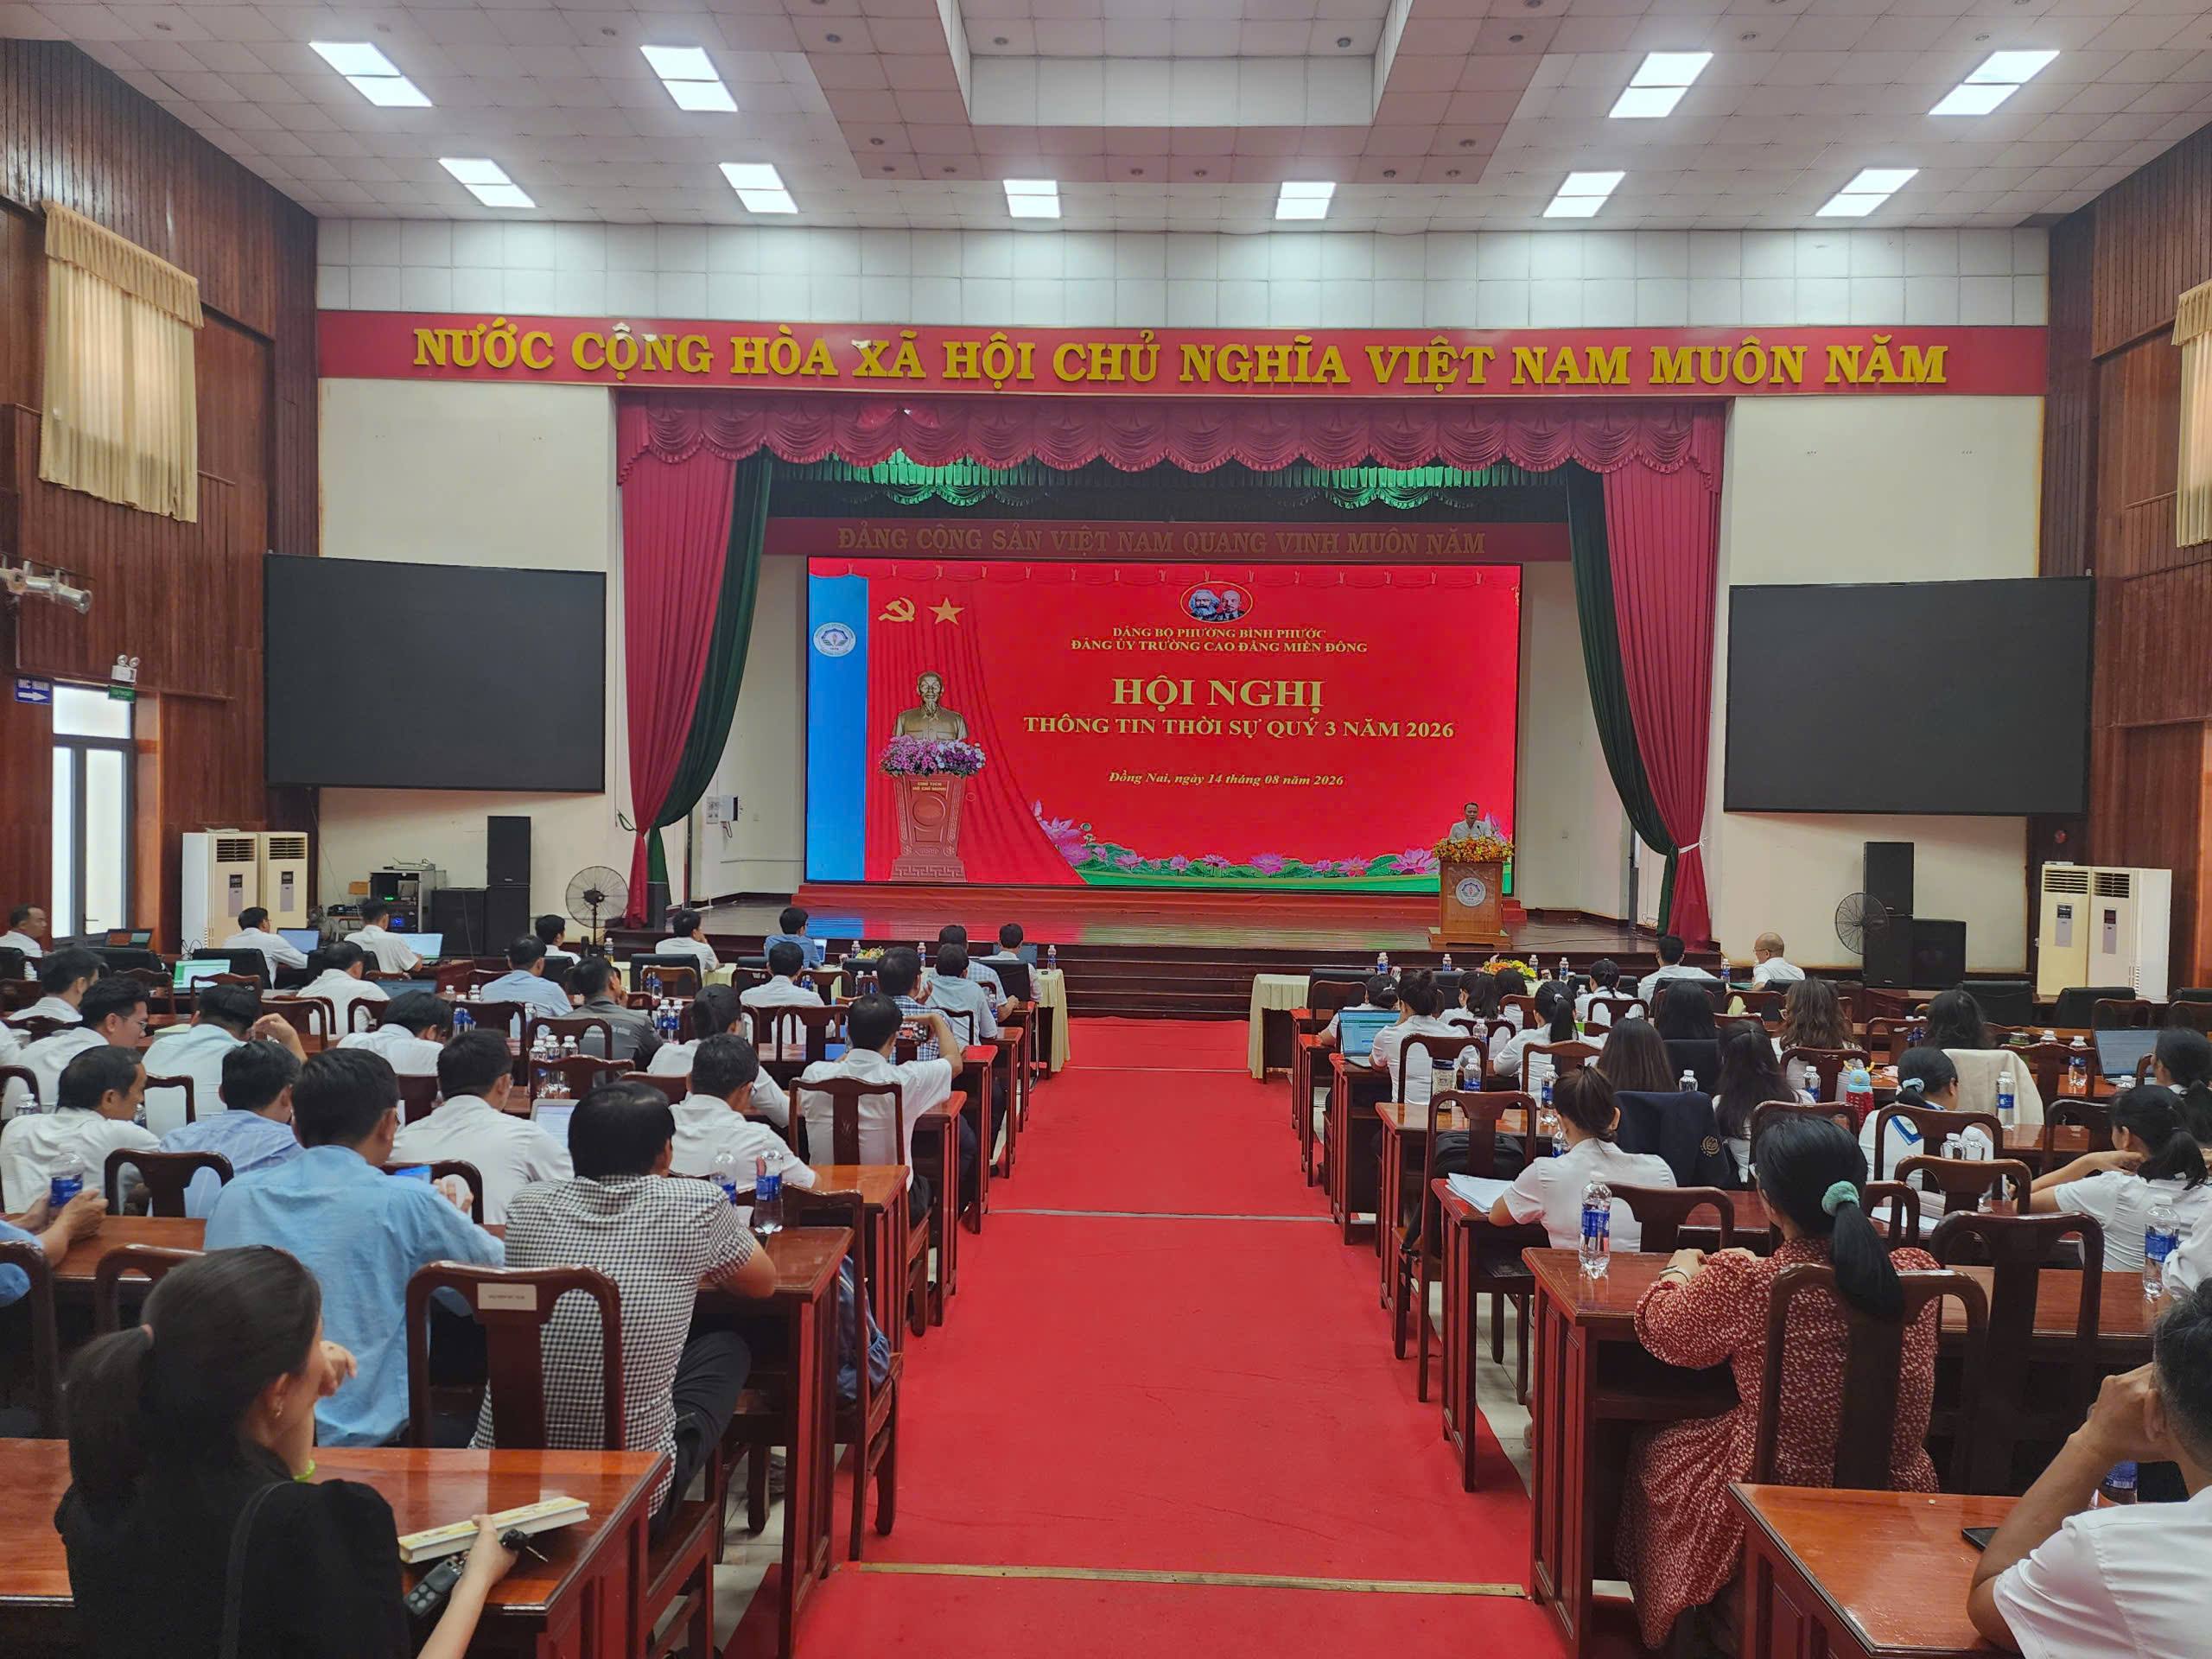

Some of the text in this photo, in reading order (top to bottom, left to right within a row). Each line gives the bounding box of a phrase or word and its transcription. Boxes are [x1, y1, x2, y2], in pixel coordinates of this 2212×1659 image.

[413, 316, 1948, 393] NƯỚC CỘNG HÒA XÃ HỘI CHỦ NGHĨA VIỆT NAM MUÔN NĂM
[838, 522, 1486, 556] ĐẢNG CỘNG SẢN VIỆT NAM QUANG VINH MUÔN NĂM
[1204, 641, 1236, 652] CAO
[1111, 675, 1325, 714] HỘI NGHỊ
[1023, 714, 1454, 739] THÔNG TIN THỜI SỰ QUÝ 3 NĂM 2026
[1146, 772, 1171, 784] Nai,
[1174, 773, 1205, 785] ngày
[1208, 774, 1223, 784] 14
[1225, 773, 1262, 787] tháng
[1264, 775, 1280, 785] 08
[1283, 775, 1311, 785] năm
[1313, 775, 1344, 785] 2026
